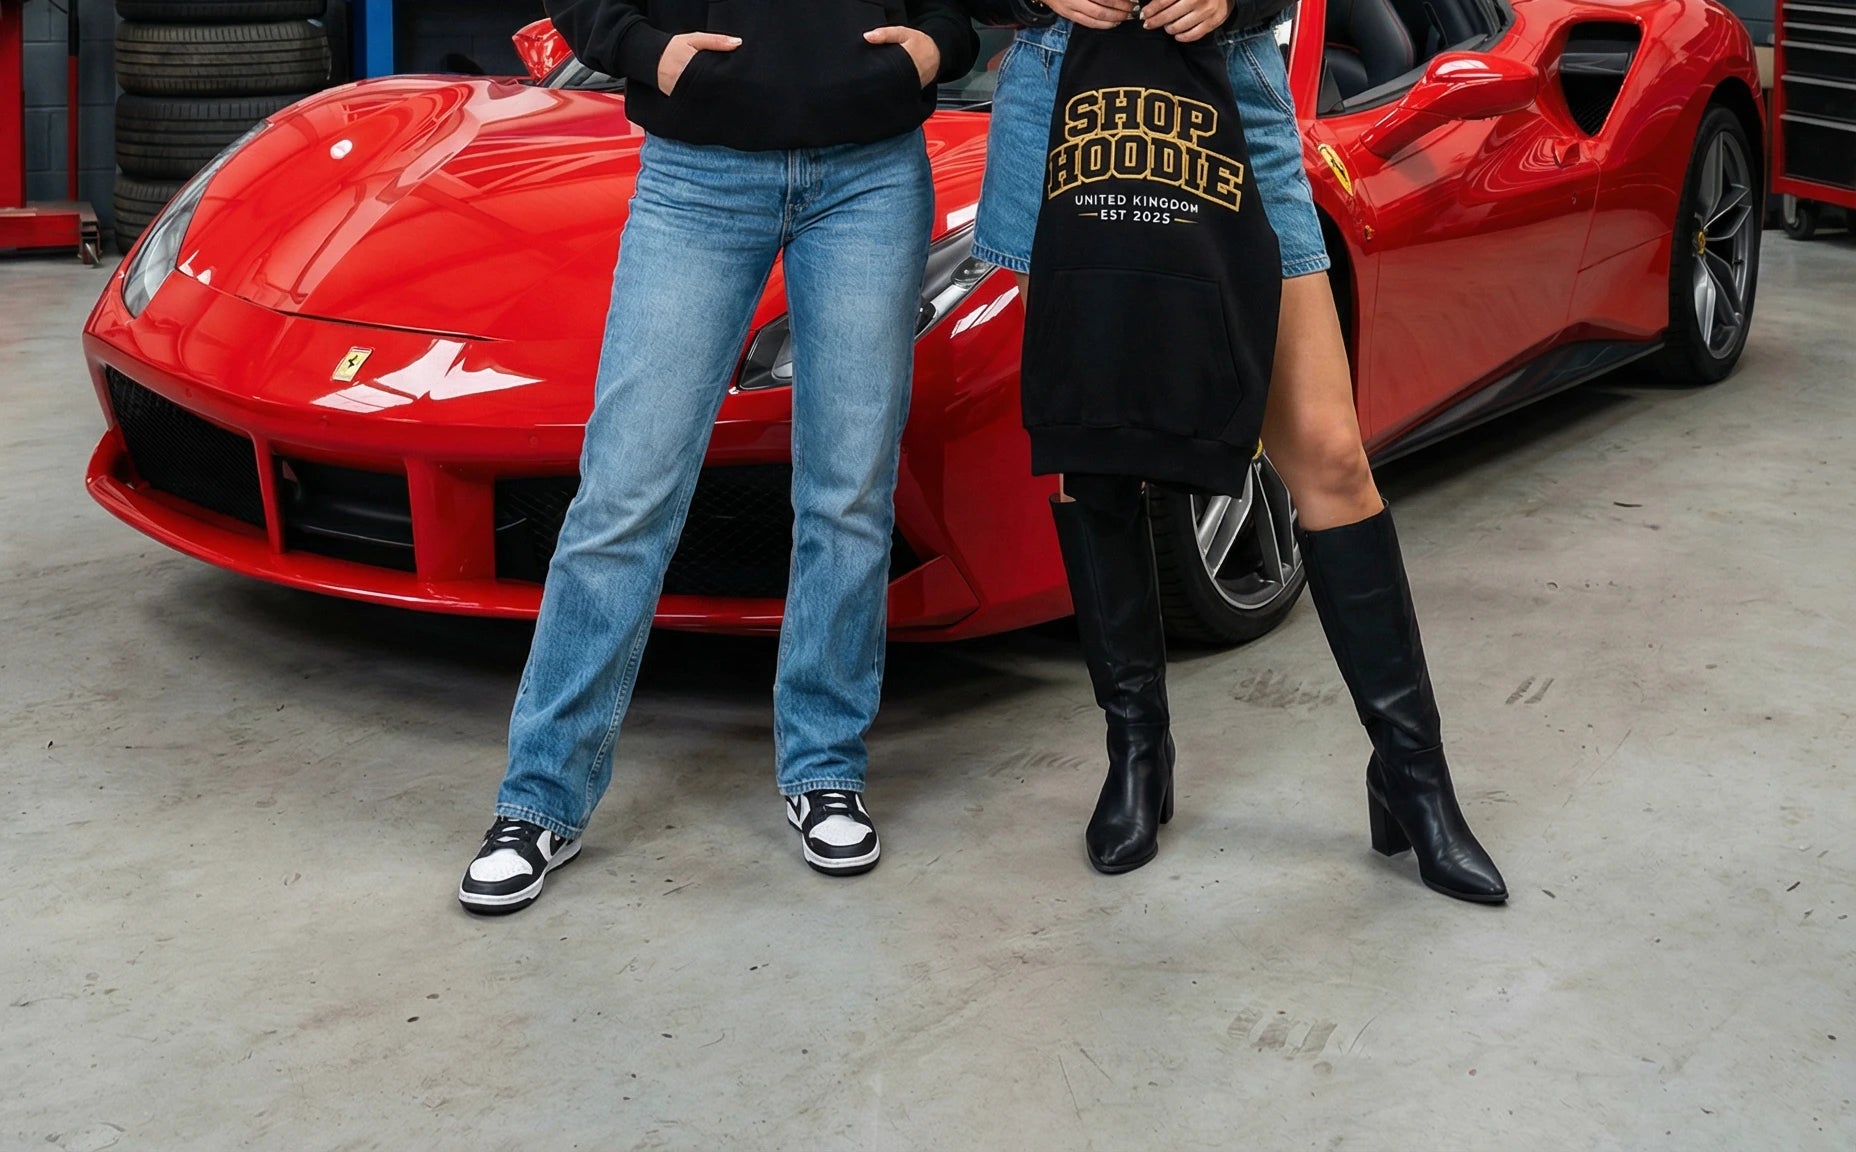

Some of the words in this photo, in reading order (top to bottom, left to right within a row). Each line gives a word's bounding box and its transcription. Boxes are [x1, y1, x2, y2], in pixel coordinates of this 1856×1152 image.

[1065, 87, 1218, 146] SHOP
[1048, 132, 1244, 212] HOODIE
[1075, 194, 1127, 206] UNITED
[1133, 196, 1199, 214] KINGDOM
[1100, 209, 1127, 221] EST
[1133, 210, 1171, 225] 2025
